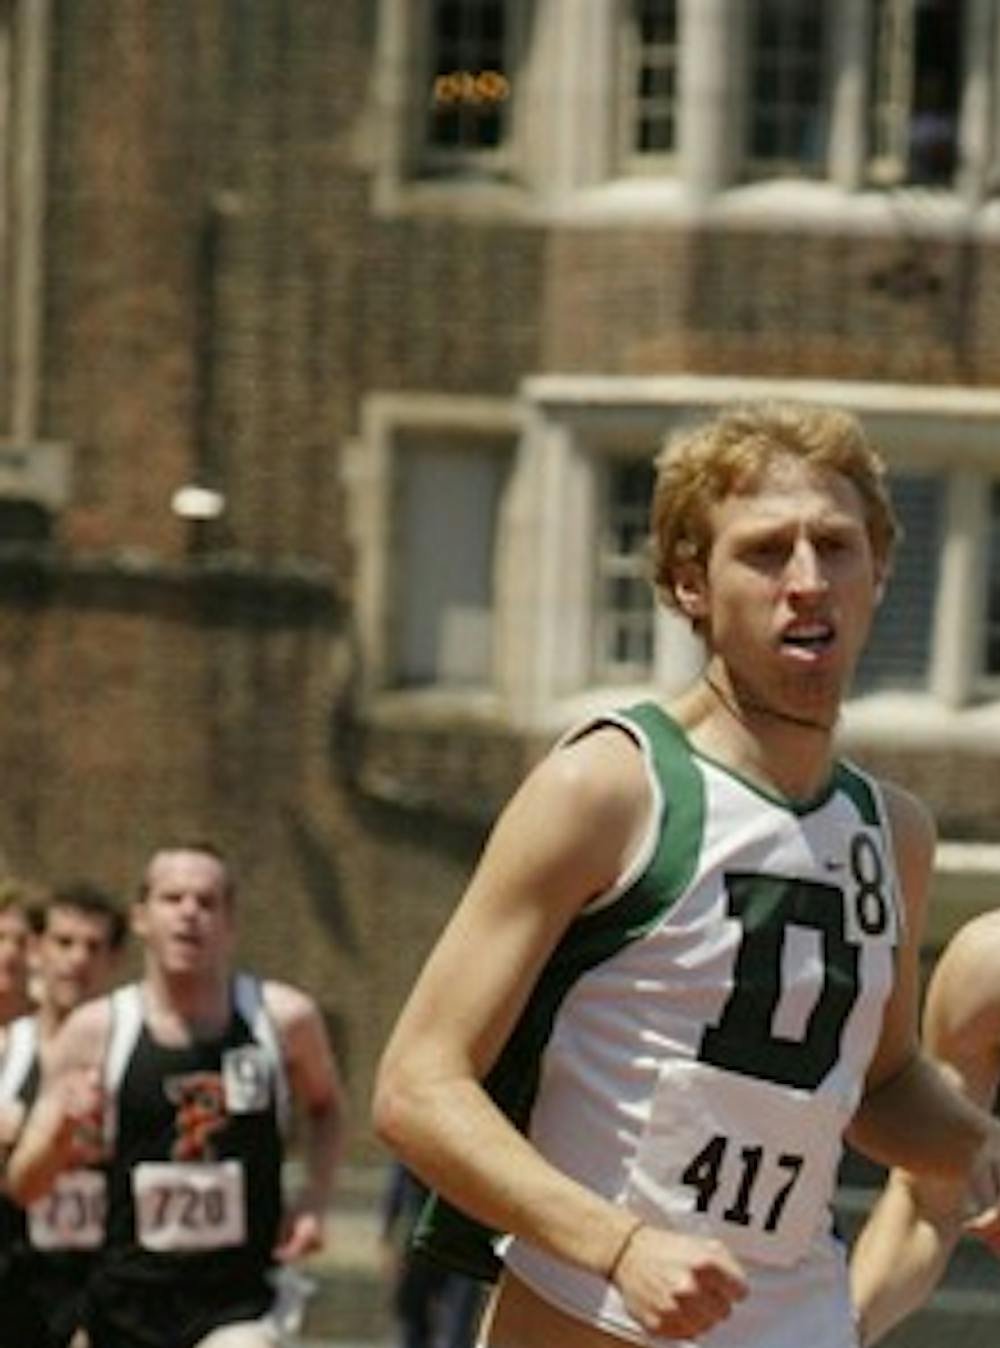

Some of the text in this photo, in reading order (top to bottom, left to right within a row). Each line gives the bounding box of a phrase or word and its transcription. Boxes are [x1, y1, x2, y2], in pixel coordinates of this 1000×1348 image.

[851, 833, 887, 936] 8
[697, 872, 861, 1091] D
[681, 1136, 804, 1232] 417
